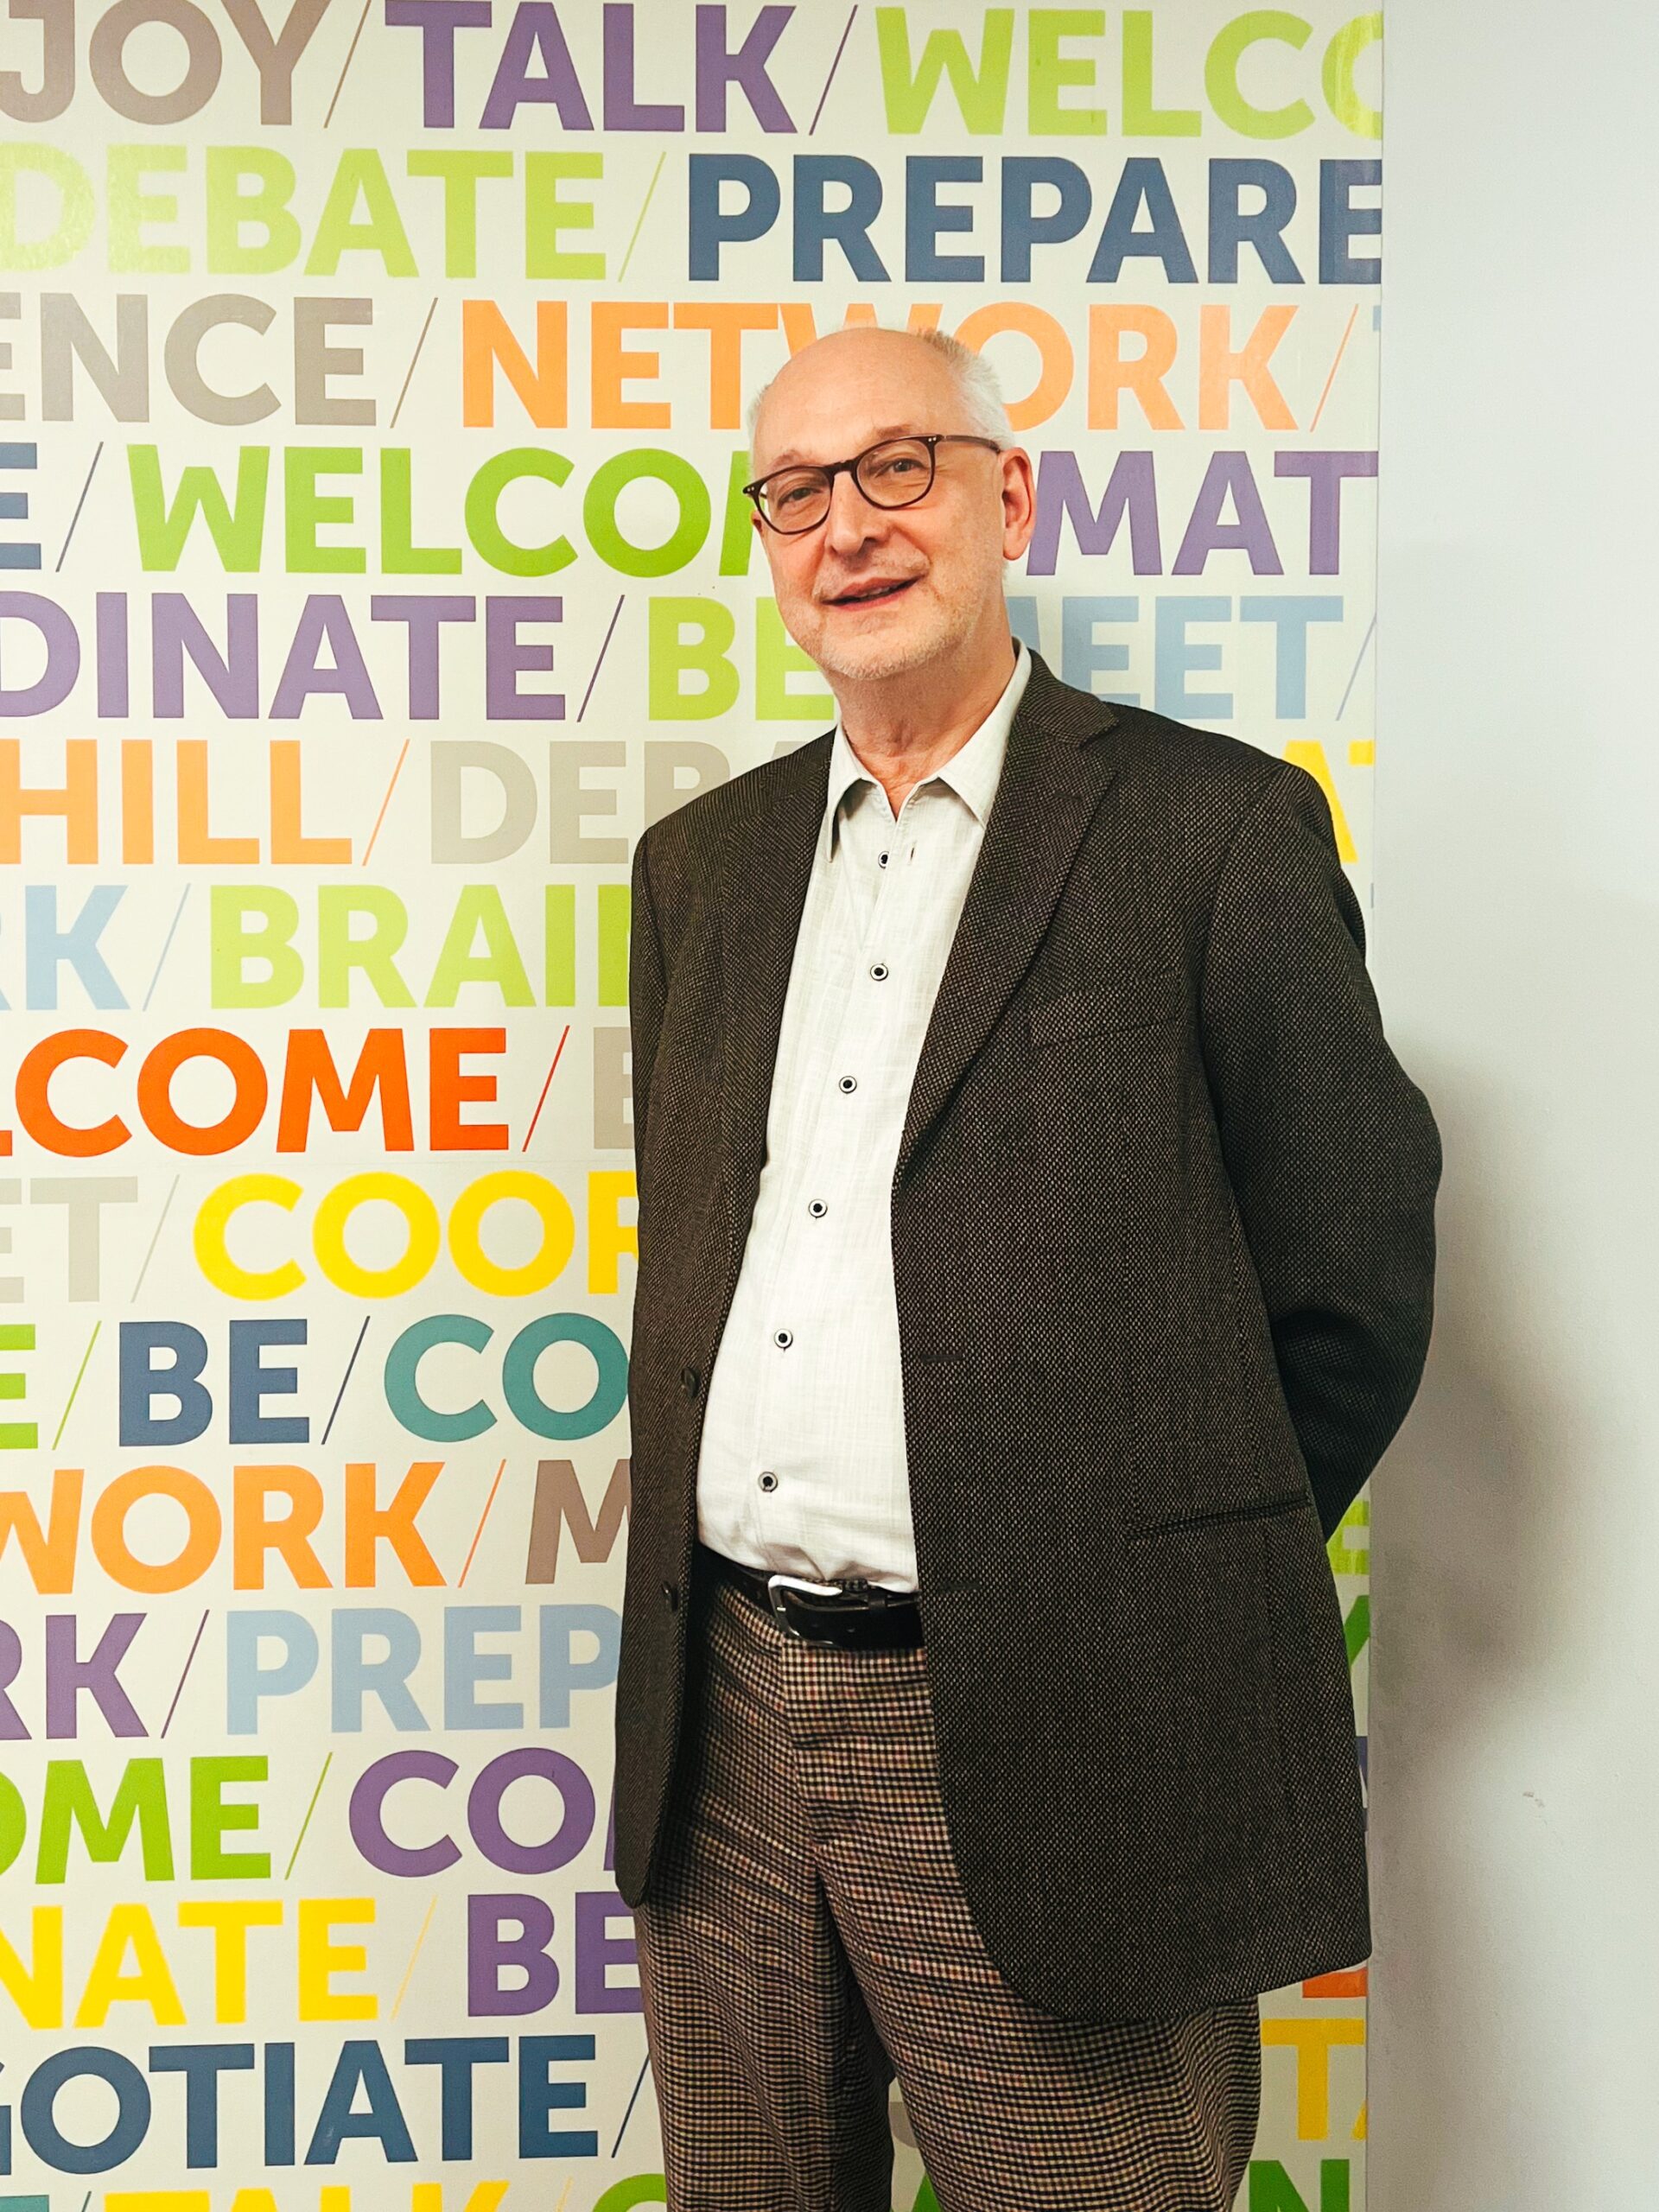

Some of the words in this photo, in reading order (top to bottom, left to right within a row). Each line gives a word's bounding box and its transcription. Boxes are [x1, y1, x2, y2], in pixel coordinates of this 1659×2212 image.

[0, 0, 330, 126] JOY
[385, 0, 798, 134] TALK
[0, 141, 607, 282] DEBATE
[689, 153, 1382, 285] PREPARE
[462, 300, 1299, 431] NETORK
[127, 445, 754, 578] WELCO
[1027, 451, 1379, 575] MAT
[648, 596, 835, 721] BE
[1004, 595, 1344, 720] EET
[0, 1027, 510, 1159] COME
[119, 1319, 309, 1446] BE
[226, 1604, 622, 1736] PREP
[0, 1756, 272, 1885] ME
[349, 1747, 616, 1878] CO
[467, 1891, 645, 2018] BE
[0, 2034, 599, 2176] OTIATE
